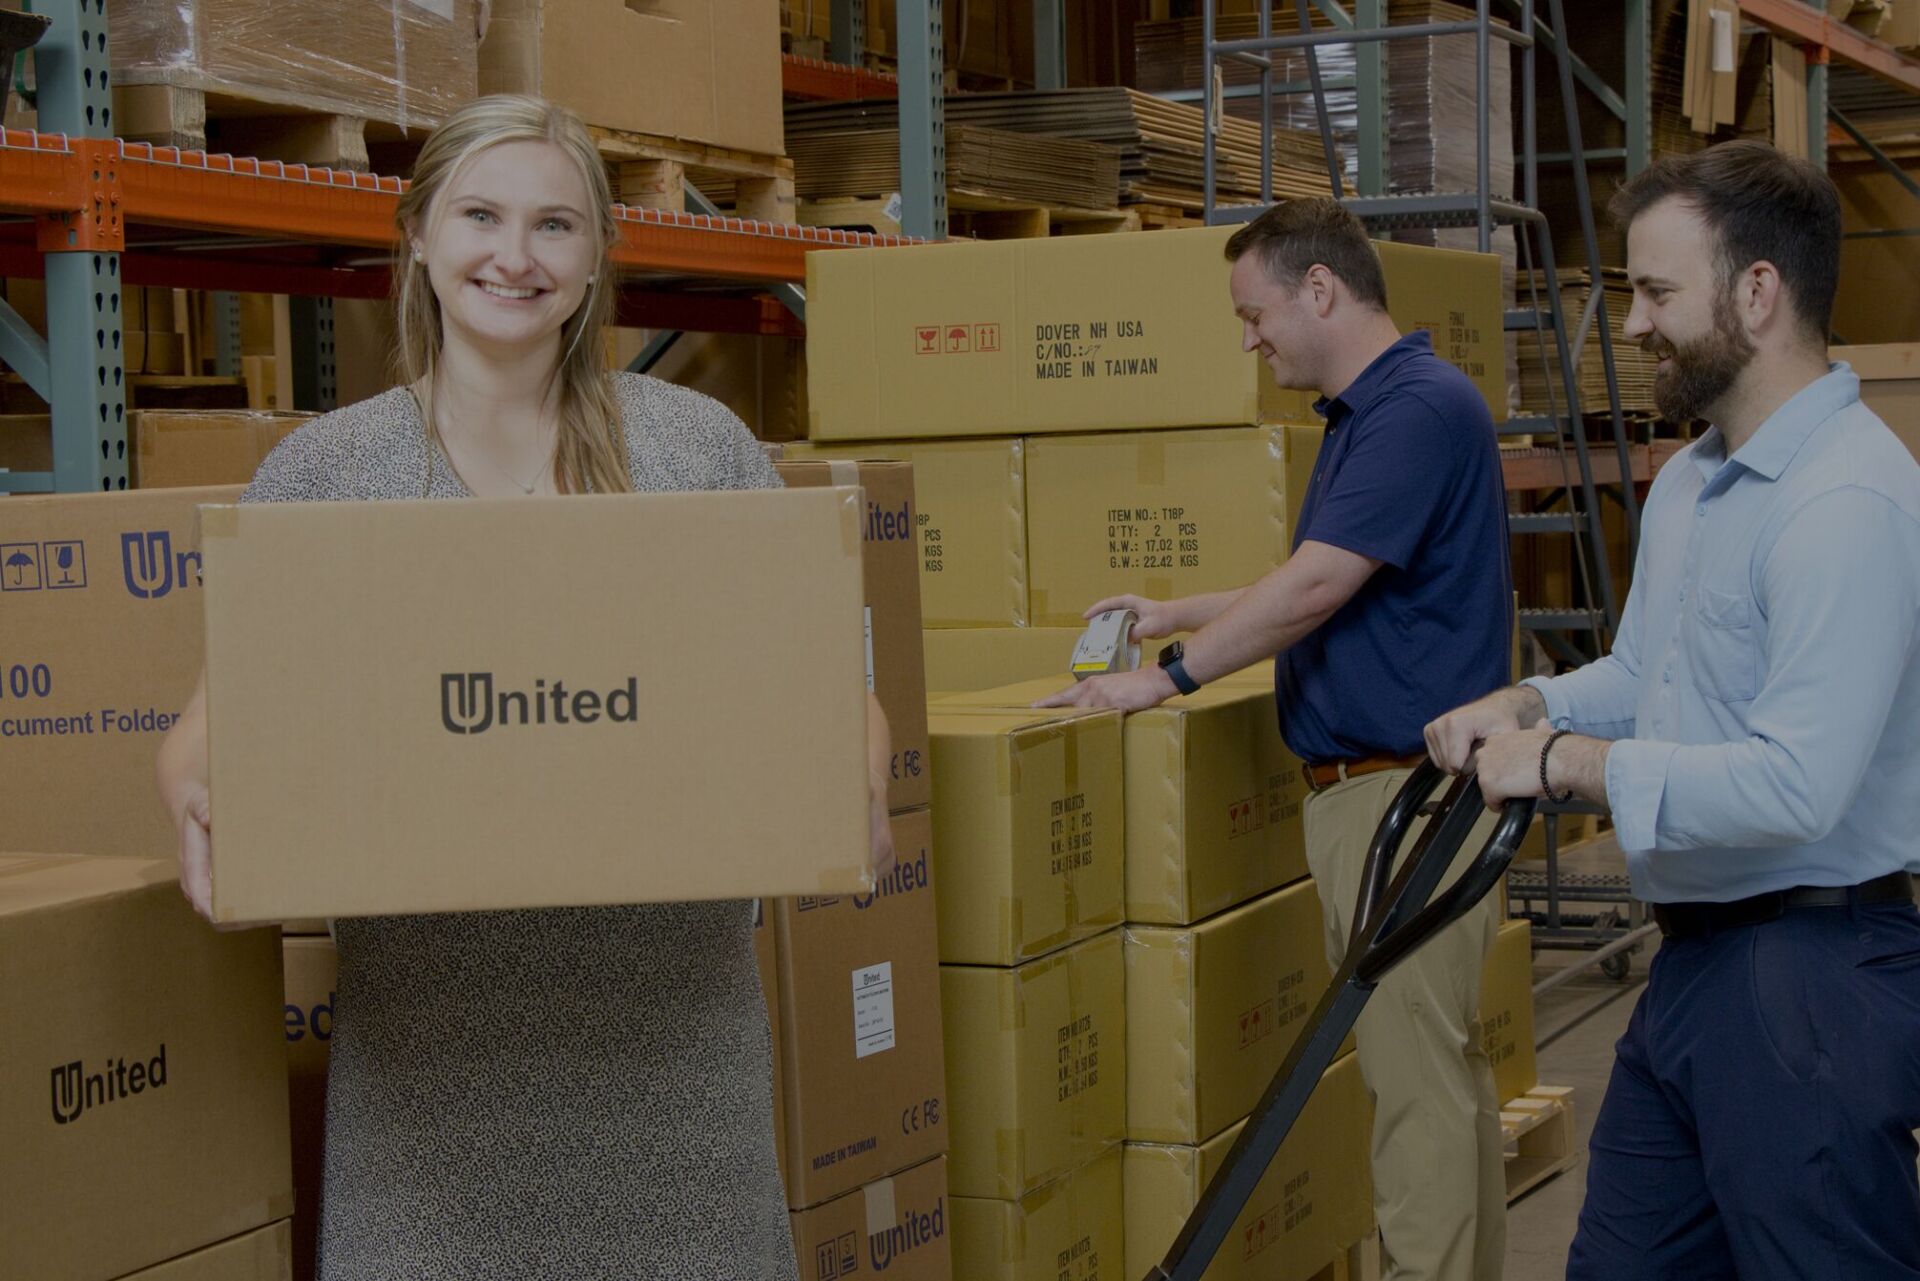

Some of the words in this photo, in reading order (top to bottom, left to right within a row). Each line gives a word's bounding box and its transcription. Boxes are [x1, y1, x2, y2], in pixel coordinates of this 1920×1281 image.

[1036, 323, 1080, 340] DOVER
[1089, 321, 1107, 339] NH
[1117, 320, 1143, 337] USA
[1036, 362, 1072, 379] MADE
[1082, 360, 1095, 377] IN
[1104, 358, 1157, 376] TAIWAN
[864, 501, 909, 541] ited
[1108, 509, 1131, 522] ITEM
[1135, 508, 1157, 521] NO.:
[1162, 507, 1184, 520] T18P
[924, 529, 941, 542] PCS
[1154, 524, 1160, 537] 2
[1178, 523, 1197, 536] PCS
[924, 545, 943, 557] KGS
[1109, 540, 1138, 553] N.W.:
[1145, 539, 1173, 552] 17.02
[1179, 539, 1198, 552] KGS
[121, 530, 202, 599] Un
[925, 560, 944, 572] KGS
[1110, 556, 1139, 568] G.W.:
[1143, 555, 1173, 568] 22.42
[1180, 554, 1199, 567] KGS
[440, 672, 638, 734] United
[0, 711, 94, 736] cument
[285, 991, 336, 1042] ed
[51, 1043, 167, 1124] United
[812, 1150, 836, 1171] MADE
[837, 1147, 846, 1162] IN
[847, 1136, 877, 1158] TAIWAN
[869, 1196, 944, 1272] United
